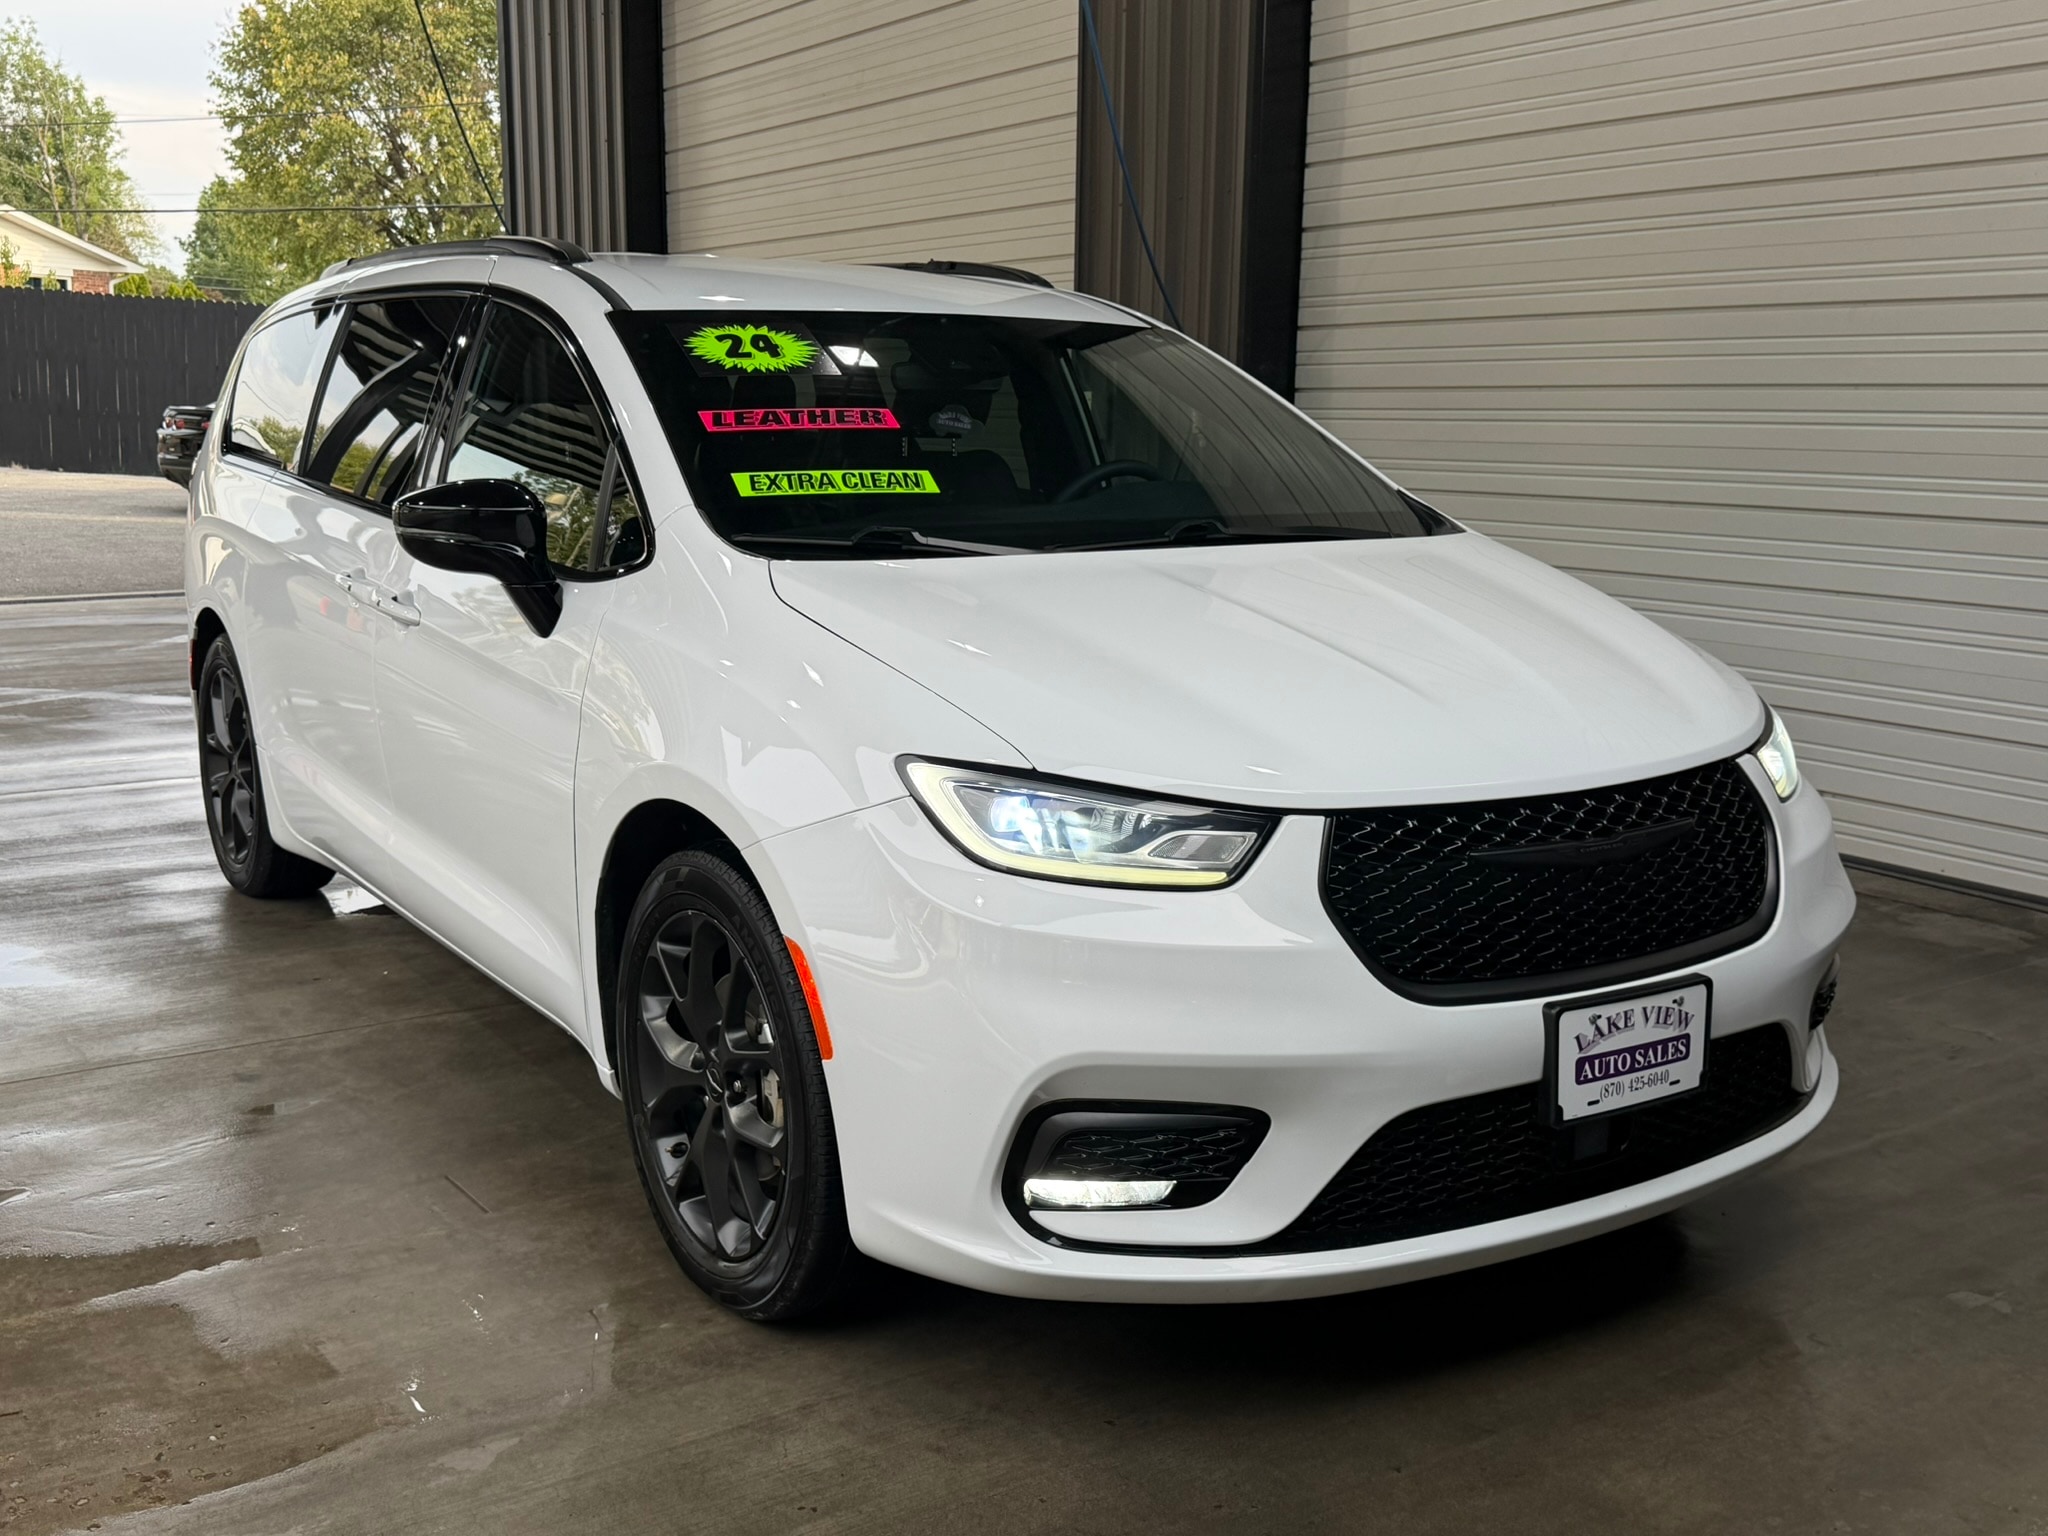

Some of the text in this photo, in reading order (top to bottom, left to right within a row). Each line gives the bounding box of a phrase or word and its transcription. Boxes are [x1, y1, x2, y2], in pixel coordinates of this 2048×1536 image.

[714, 333, 782, 359] 24
[711, 410, 887, 428] LEATHER
[749, 472, 926, 493] EXTRA CLEAN
[1573, 1006, 1695, 1053] LAKE VIEW
[1580, 1038, 1687, 1081] AUTO SALES
[1600, 1069, 1669, 1102] (870) 425-6040
